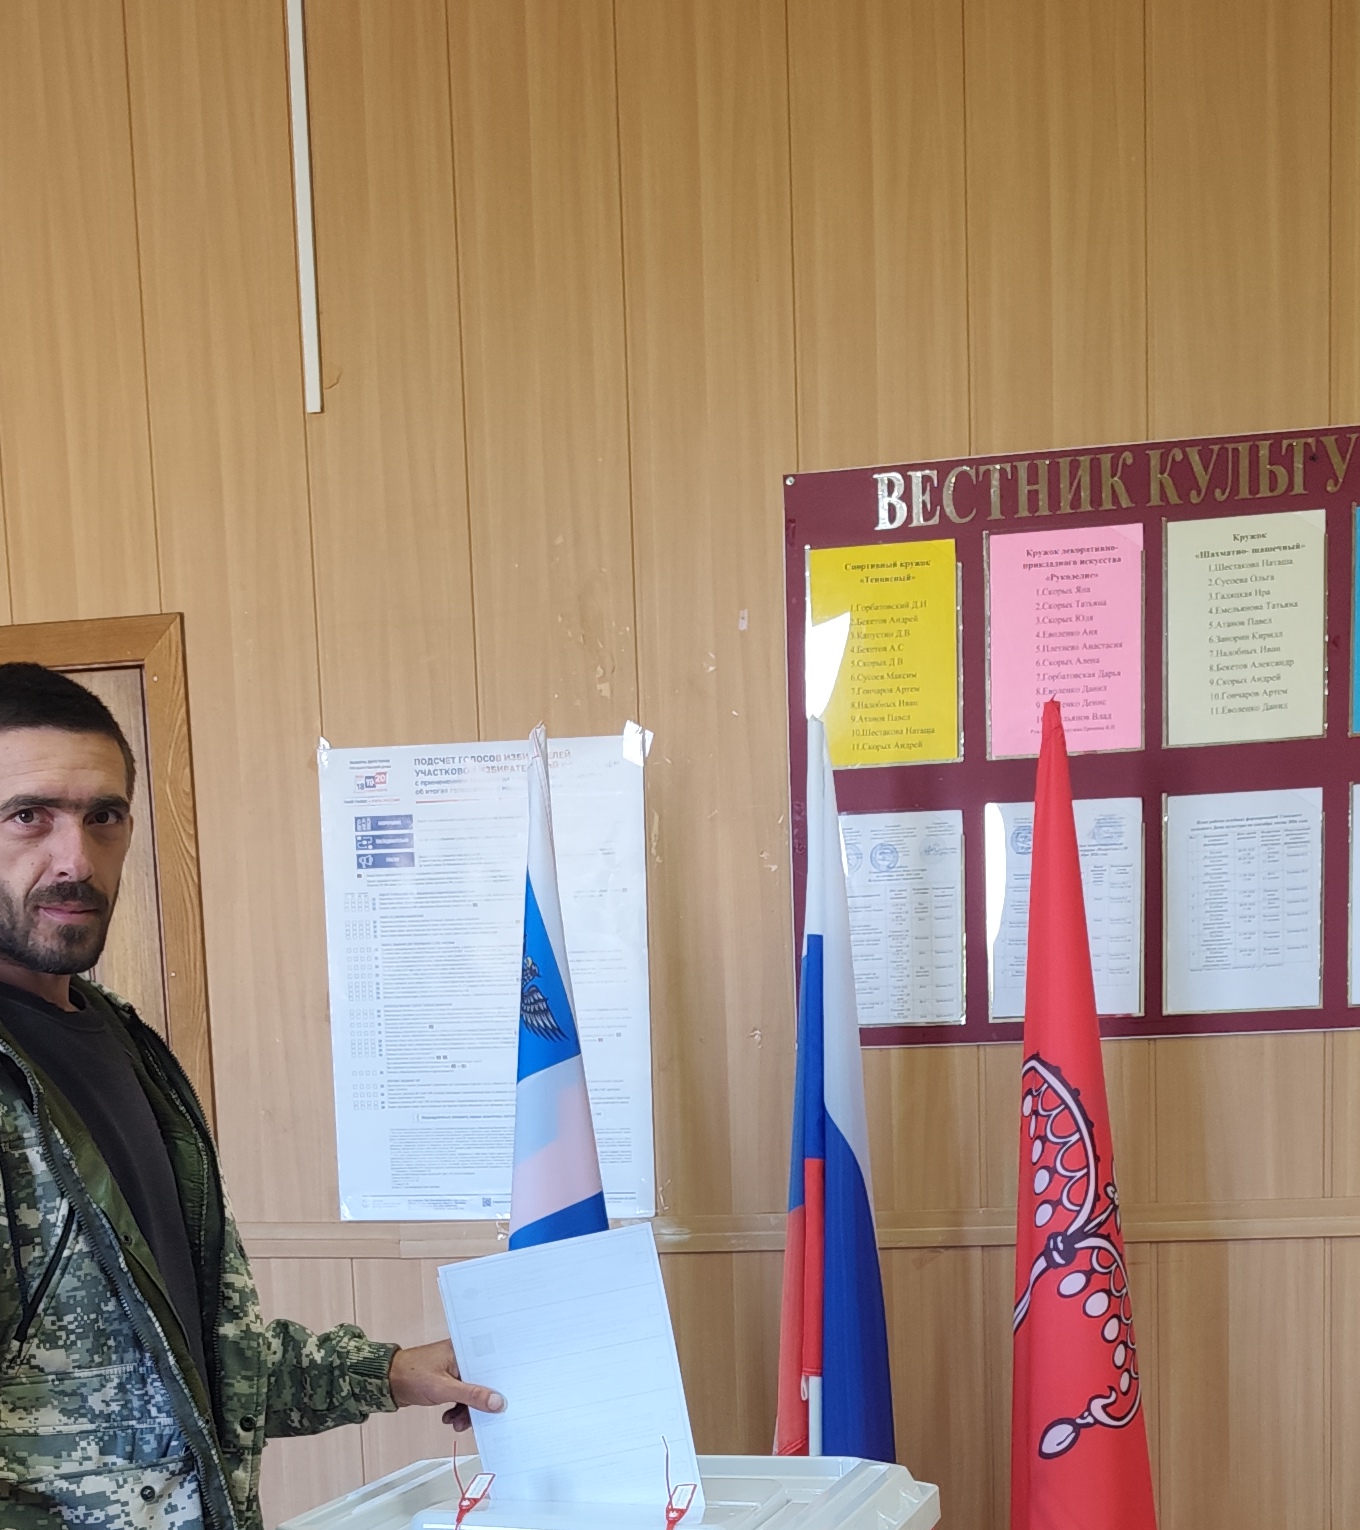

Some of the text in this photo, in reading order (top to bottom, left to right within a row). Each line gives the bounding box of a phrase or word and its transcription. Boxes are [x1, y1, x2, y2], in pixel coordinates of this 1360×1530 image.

[873, 452, 1139, 531] ВЕСТНИК
[1232, 533, 1267, 543] Кружок
[1026, 545, 1118, 558] Кружок декоративно-
[844, 560, 931, 571] Спортивный кружок
[1023, 557, 1122, 571] прикладного искусства
[414, 757, 456, 766] ПОДСЧЕТ
[414, 767, 472, 777] УЧАСТКОВО
